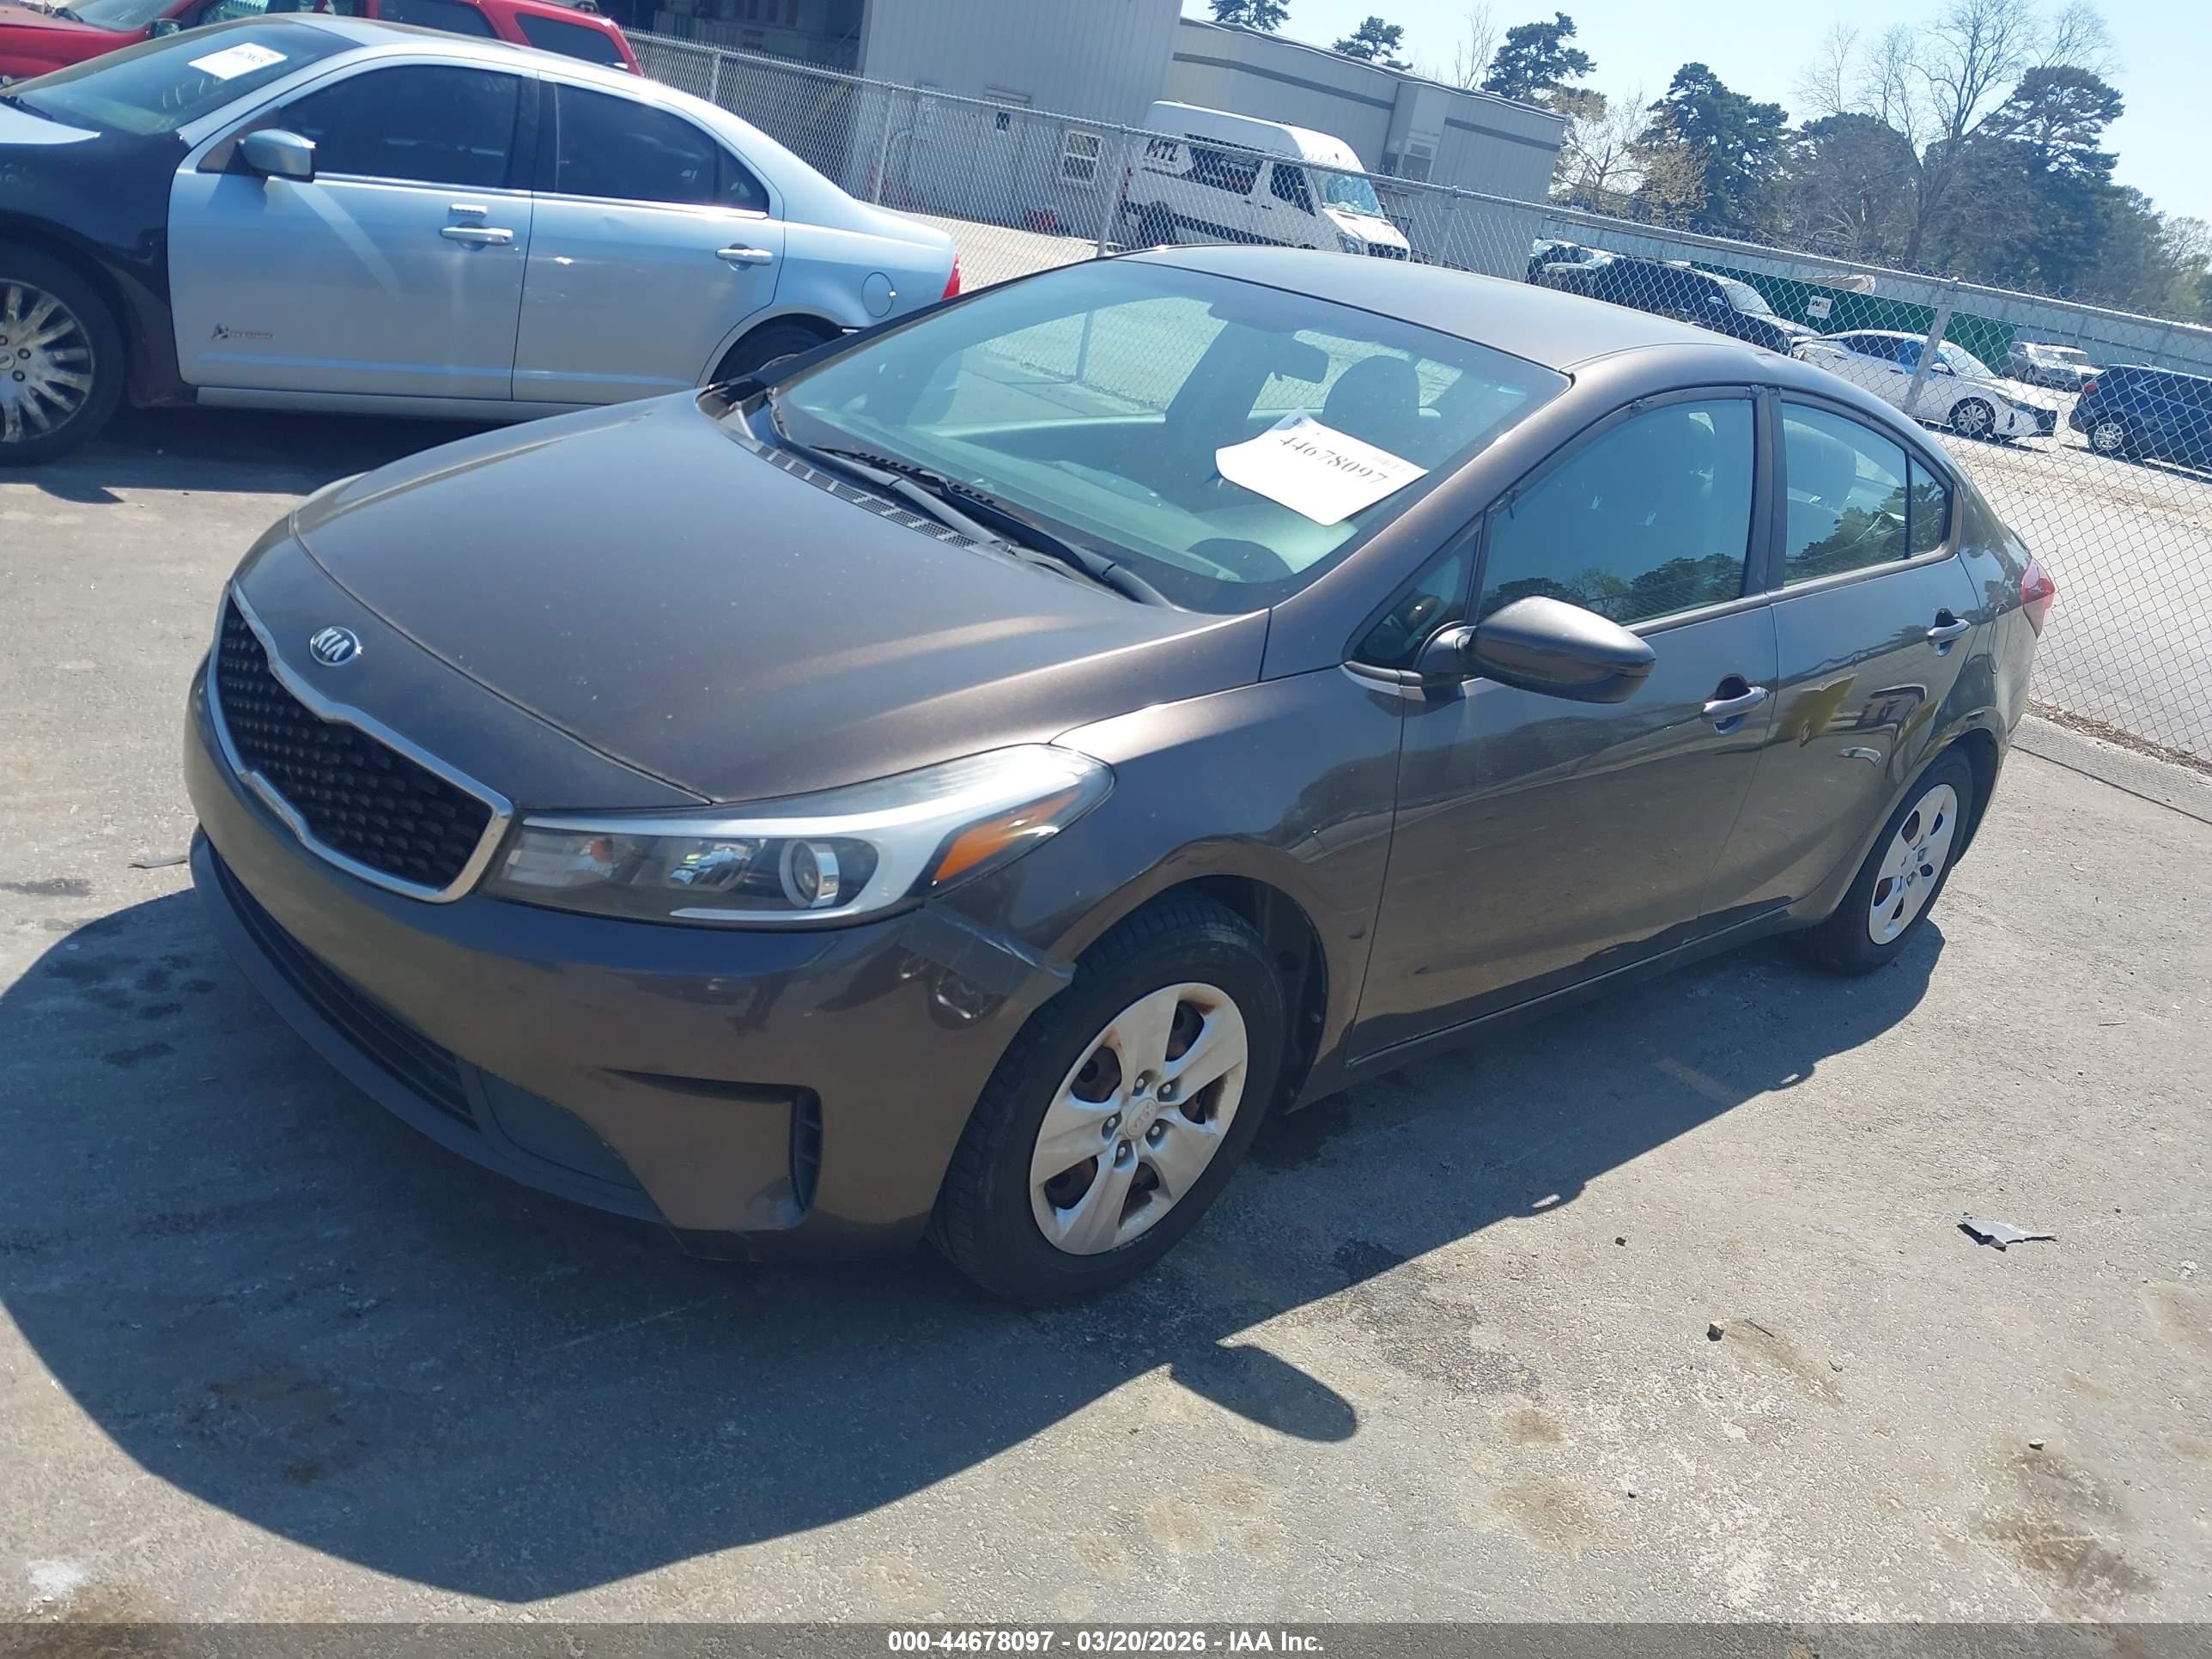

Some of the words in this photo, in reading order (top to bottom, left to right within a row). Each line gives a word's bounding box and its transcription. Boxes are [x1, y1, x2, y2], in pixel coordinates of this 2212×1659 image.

[1146, 138, 1179, 162] MTL
[1279, 436, 1389, 484] 44678097
[313, 628, 350, 661] KIA
